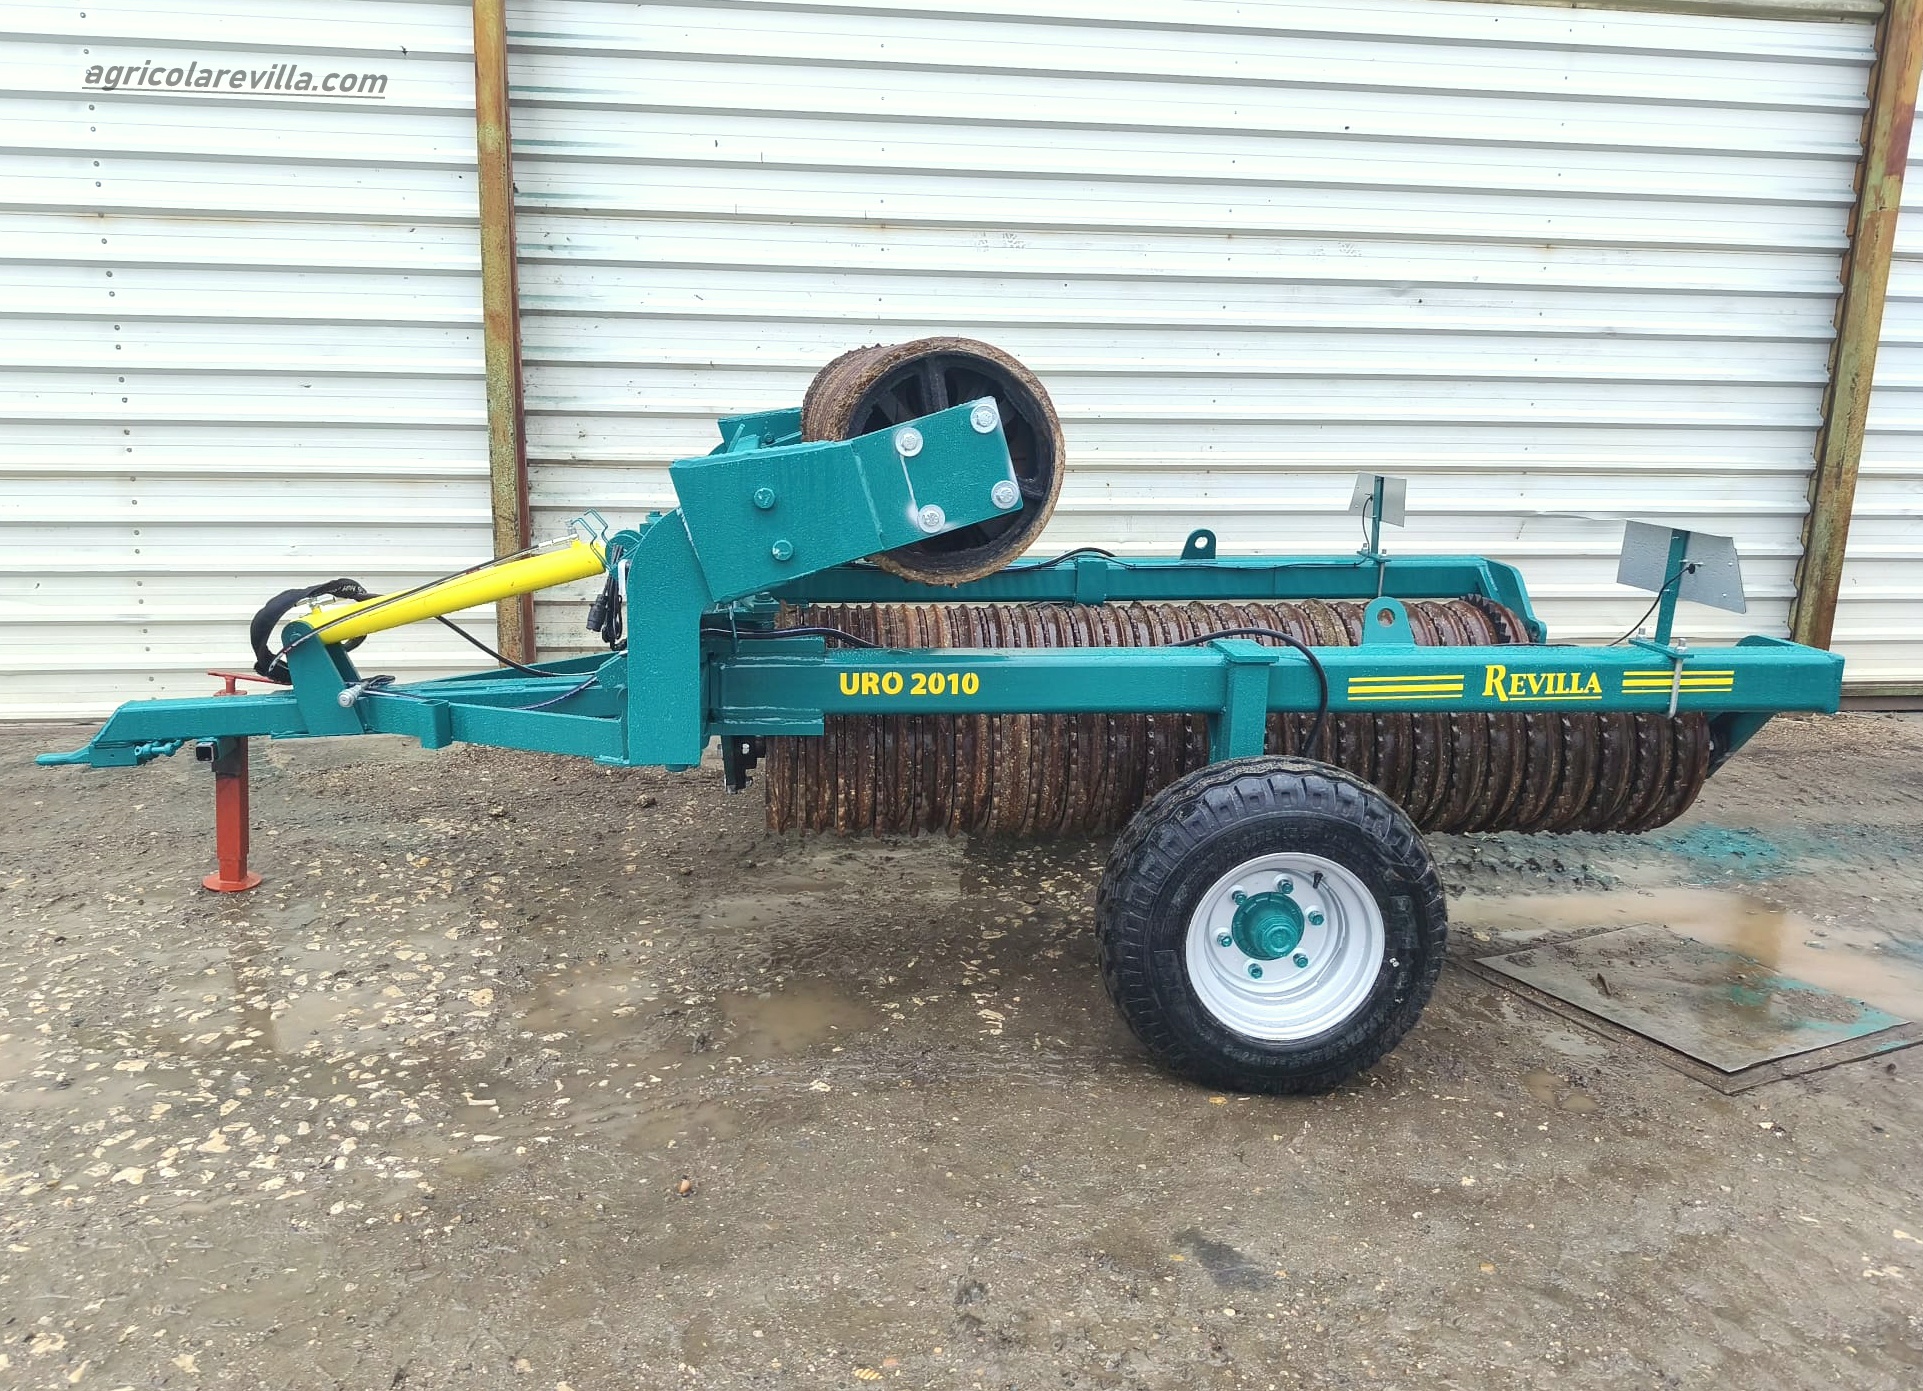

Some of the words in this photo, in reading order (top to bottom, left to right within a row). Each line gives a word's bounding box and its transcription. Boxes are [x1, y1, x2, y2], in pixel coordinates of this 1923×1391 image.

[839, 671, 904, 696] URO
[909, 671, 980, 696] 2010
[1482, 664, 1602, 701] REVILLA
